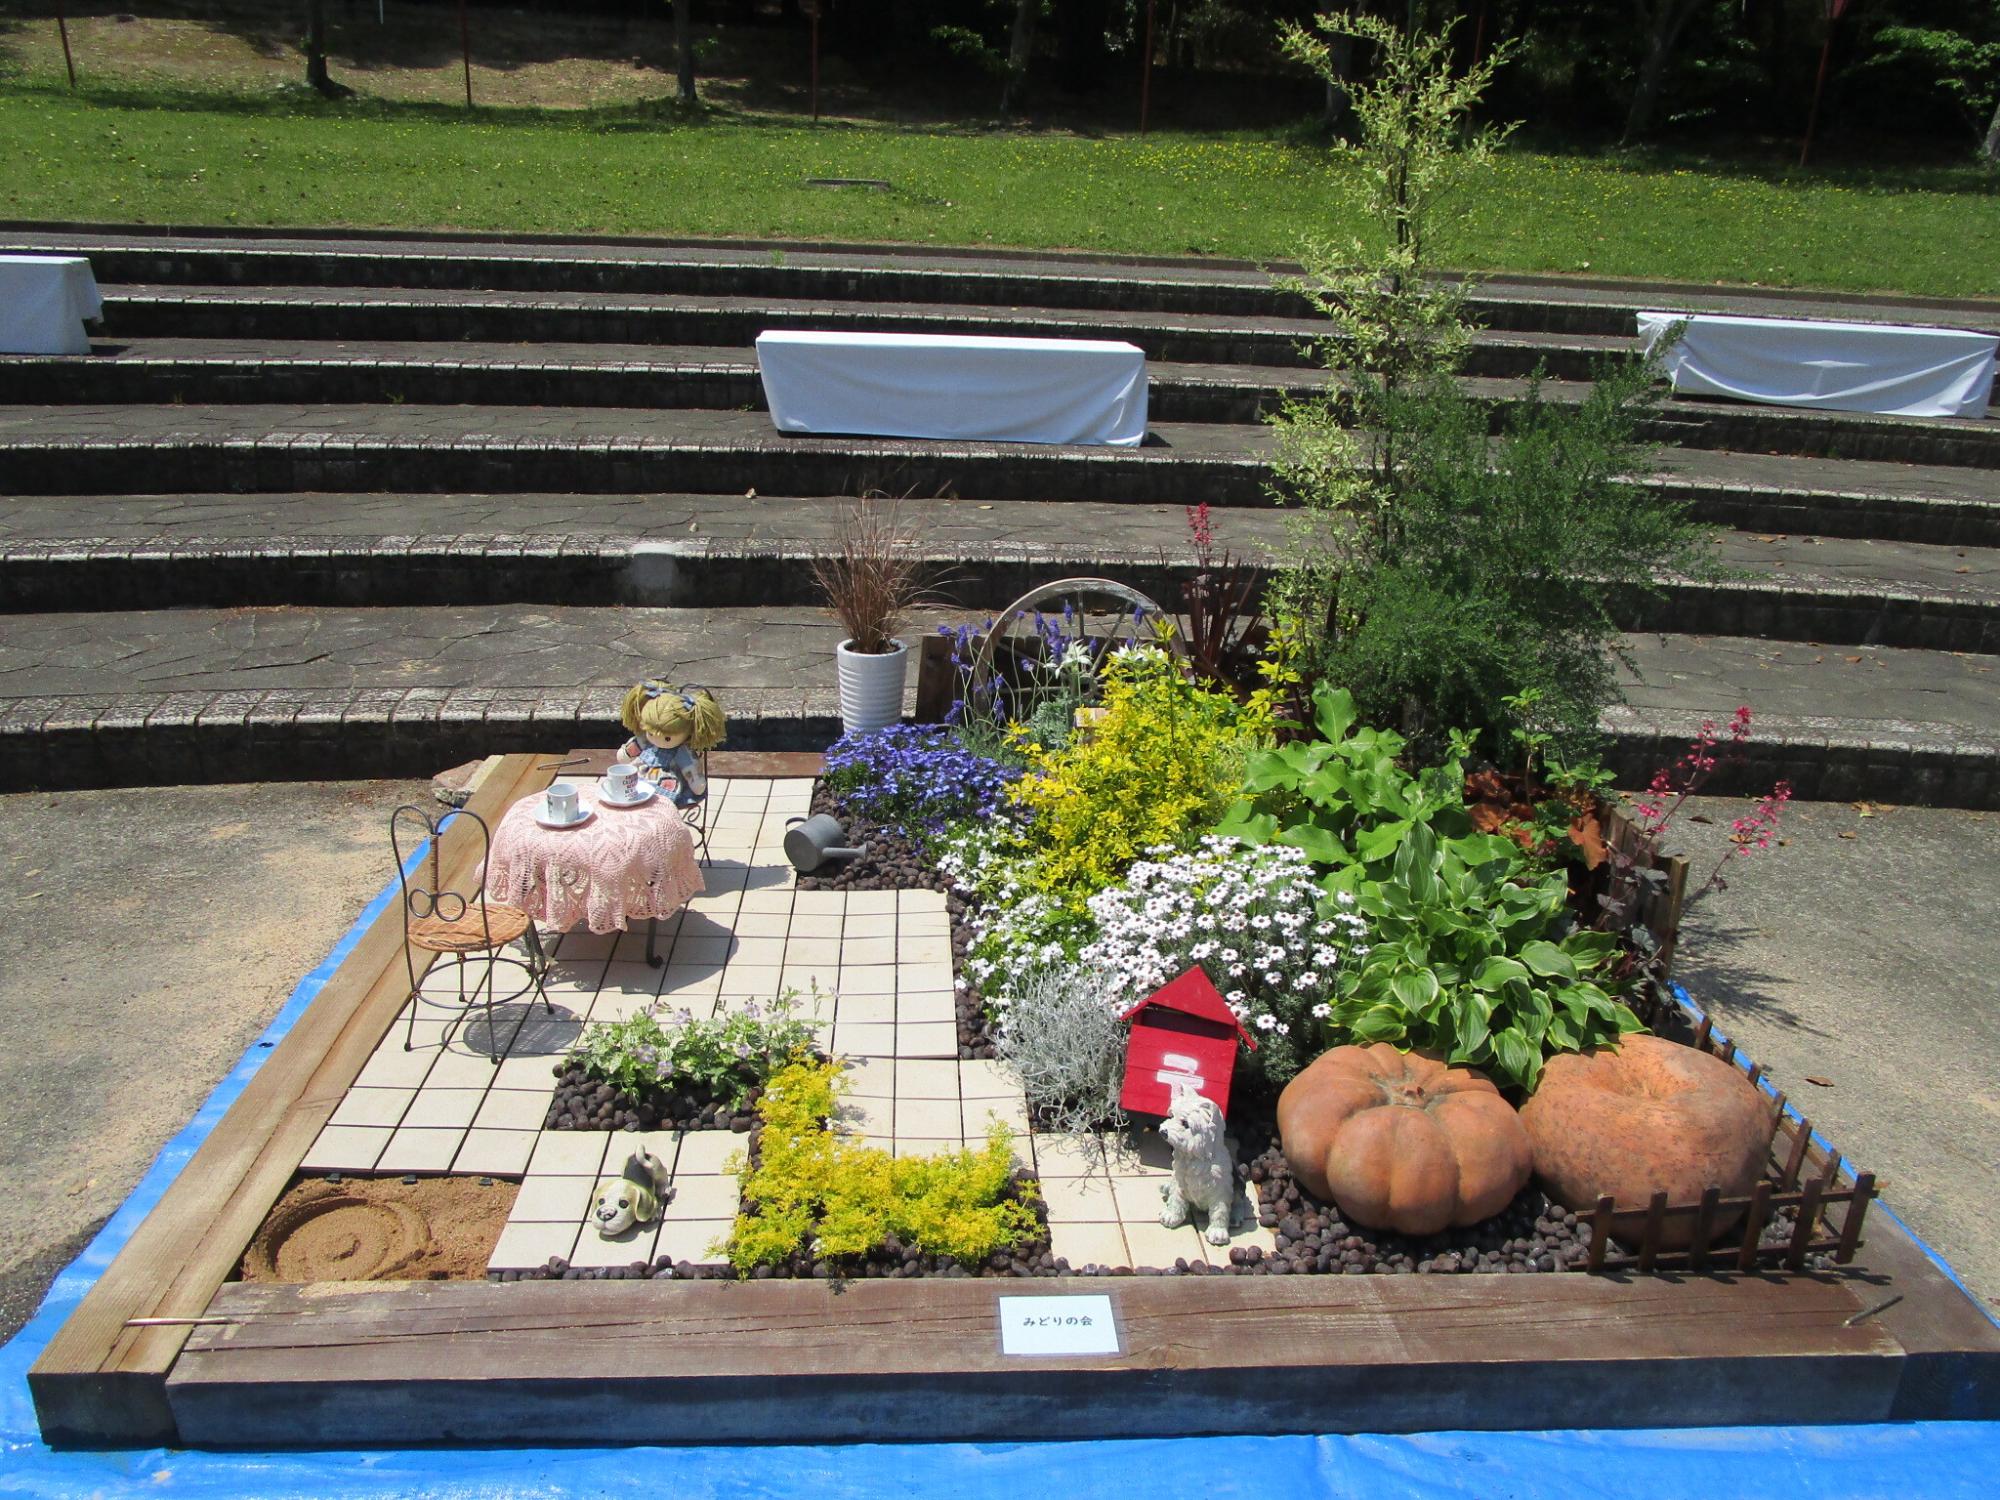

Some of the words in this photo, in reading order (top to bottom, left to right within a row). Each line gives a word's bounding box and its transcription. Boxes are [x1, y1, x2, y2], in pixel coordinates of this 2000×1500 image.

[1023, 1315, 1093, 1326] みどりの会
